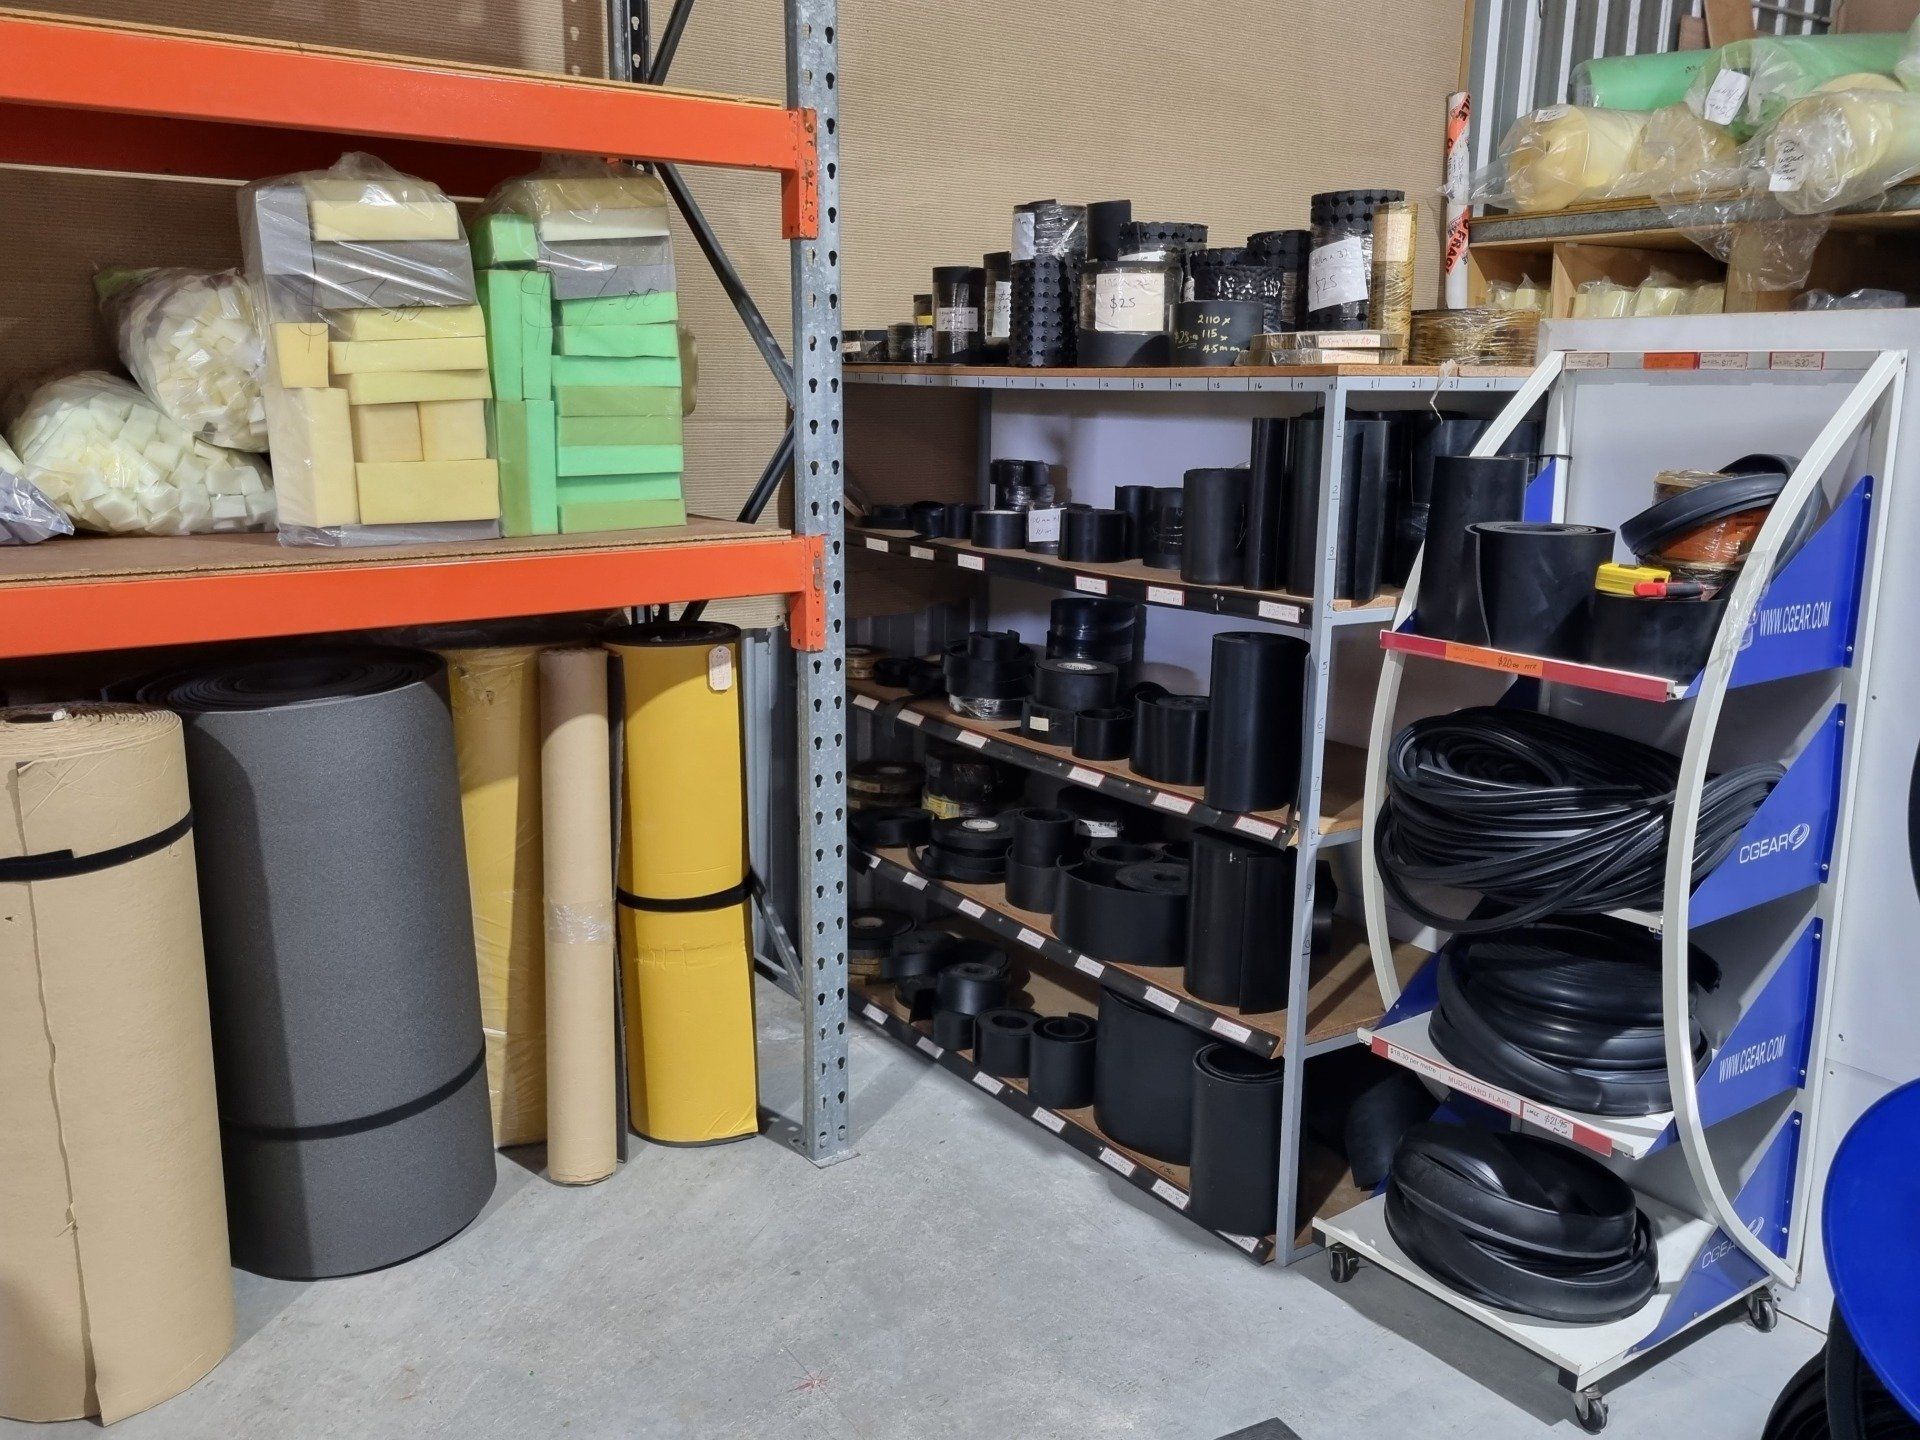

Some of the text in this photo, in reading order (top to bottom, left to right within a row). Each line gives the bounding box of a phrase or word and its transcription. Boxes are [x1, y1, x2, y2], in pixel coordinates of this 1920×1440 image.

[1315, 274, 1338, 303] $25
[1109, 294, 1136, 317] $25
[1197, 314, 1231, 326] 2110 x
[1202, 328, 1218, 339] 115
[1760, 601, 1832, 637] WWW.CGEAR.COM
[1321, 661, 1329, 671] 5
[1317, 717, 1324, 730] 6
[1739, 833, 1789, 864] CGEAR
[1409, 1055, 1420, 1067] per
[1419, 1061, 1437, 1074] metre
[1719, 1034, 1787, 1084] WWW.CGEAR.COM
[1447, 1075, 1512, 1108] MUDGUARD FLARE
[1701, 1239, 1736, 1269] CGEA
